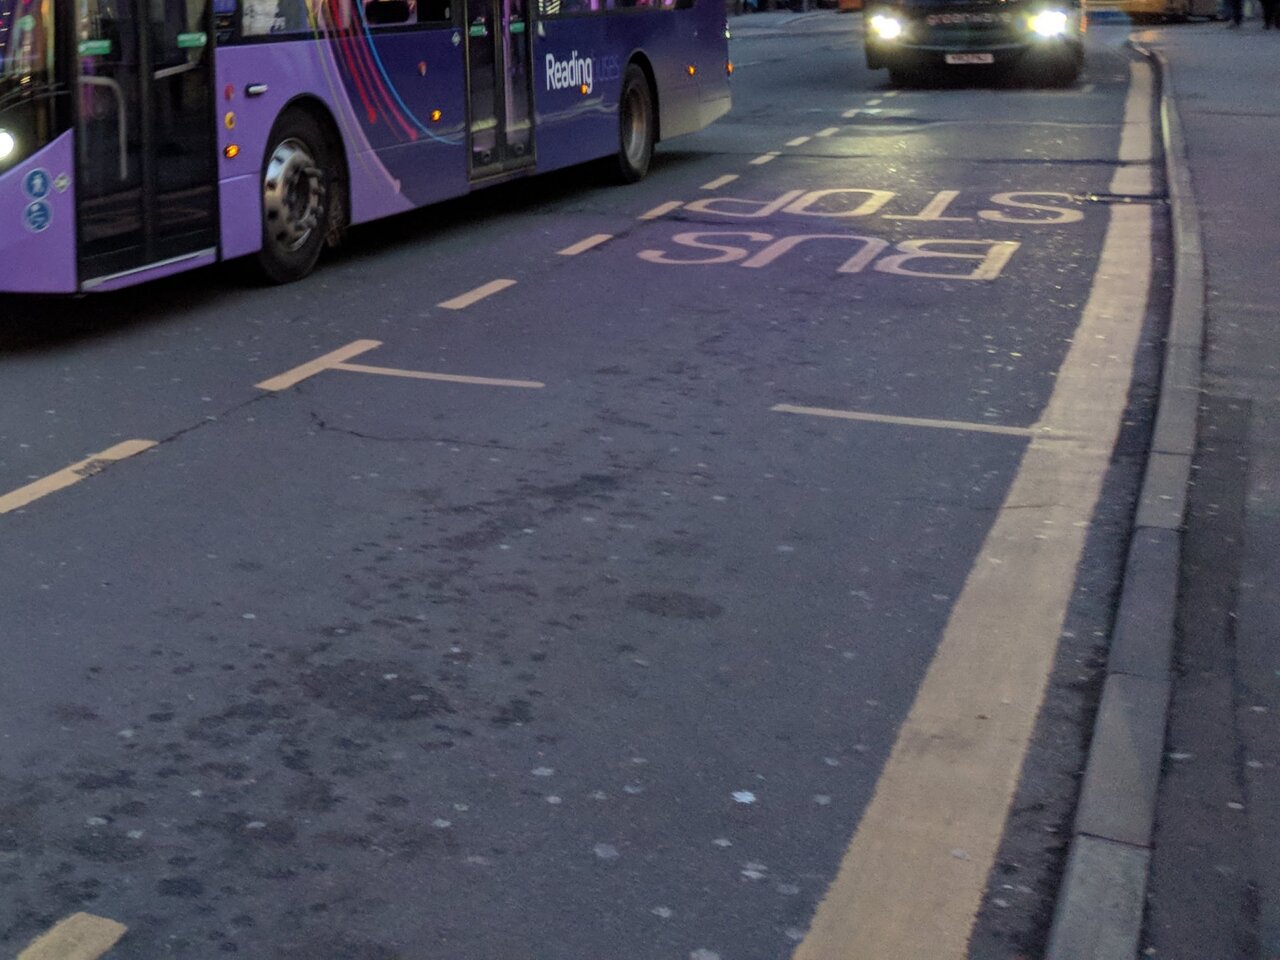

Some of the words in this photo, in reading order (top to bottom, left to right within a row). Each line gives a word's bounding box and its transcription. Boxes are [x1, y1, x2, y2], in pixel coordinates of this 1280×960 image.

[545, 50, 593, 95] Reading
[682, 188, 1085, 224] STOP
[636, 231, 1021, 281] BUS
